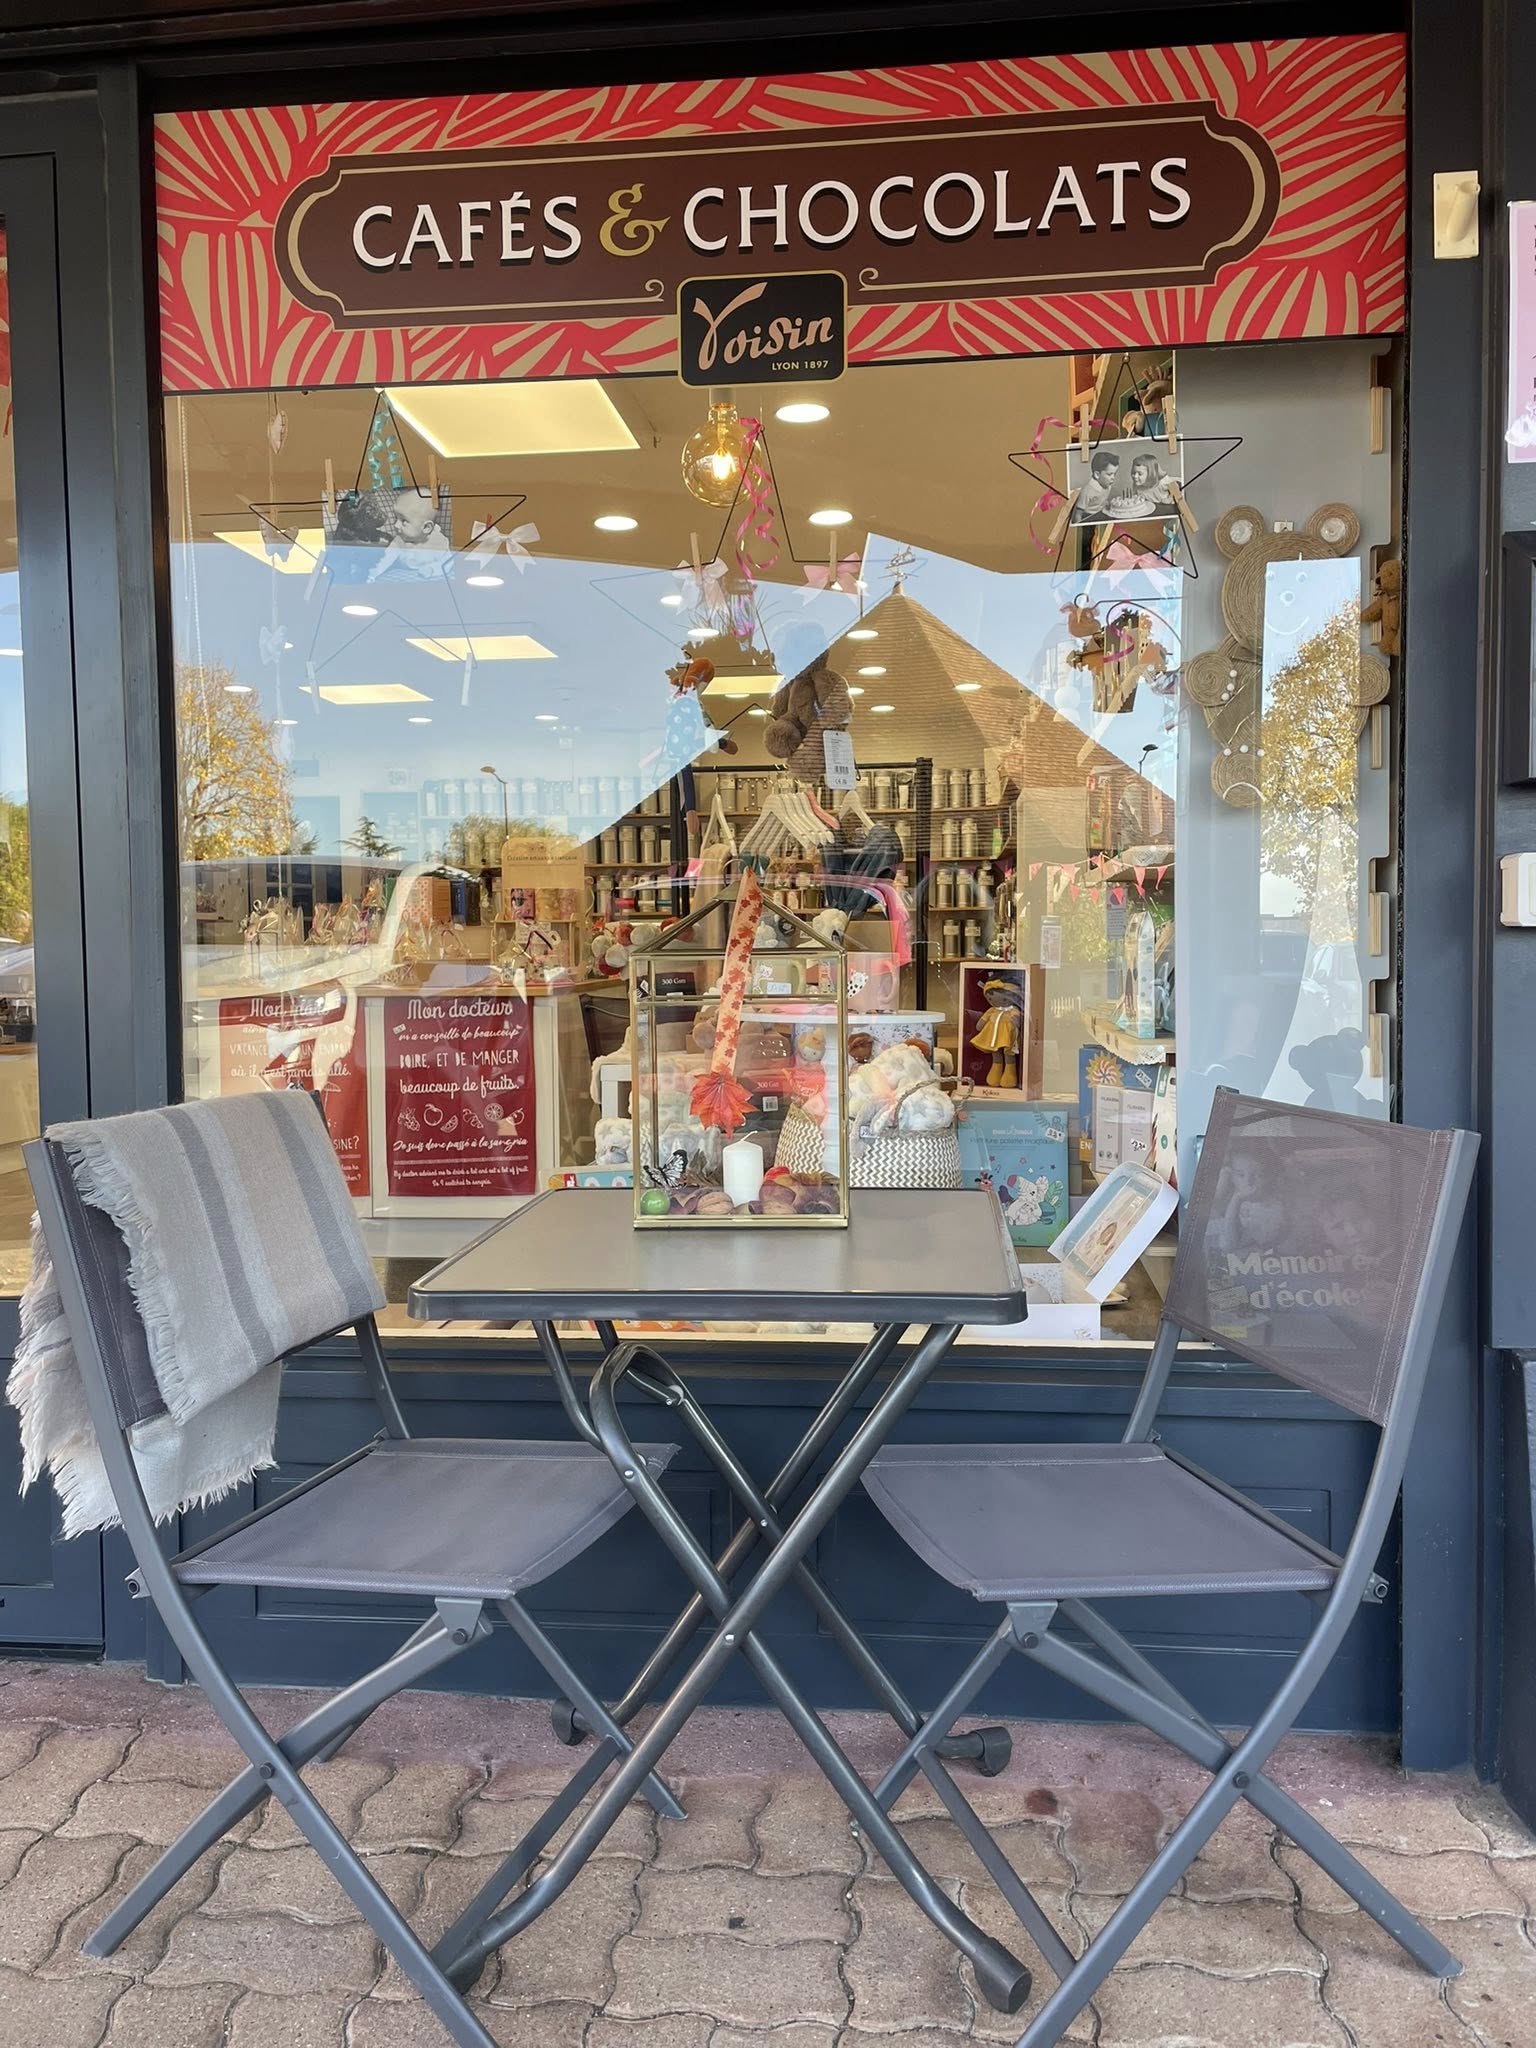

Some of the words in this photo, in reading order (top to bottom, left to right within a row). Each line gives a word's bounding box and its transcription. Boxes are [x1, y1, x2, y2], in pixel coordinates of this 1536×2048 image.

[352, 191, 583, 268] CAFÉS
[599, 183, 672, 257] &
[683, 156, 1192, 254] CHOCOLATS
[693, 281, 834, 371] Voisin
[771, 361, 800, 371] LYON
[803, 360, 829, 369] 1897
[407, 998, 445, 1019] Mon
[448, 997, 513, 1018] docteur
[436, 1053, 449, 1067] ET
[455, 1052, 467, 1066] DE
[472, 1050, 520, 1066] MANGER
[399, 1079, 460, 1099] beaucoup
[462, 1076, 479, 1092] de
[480, 1074, 519, 1098] fruits.
[487, 1137, 528, 1153] sangria
